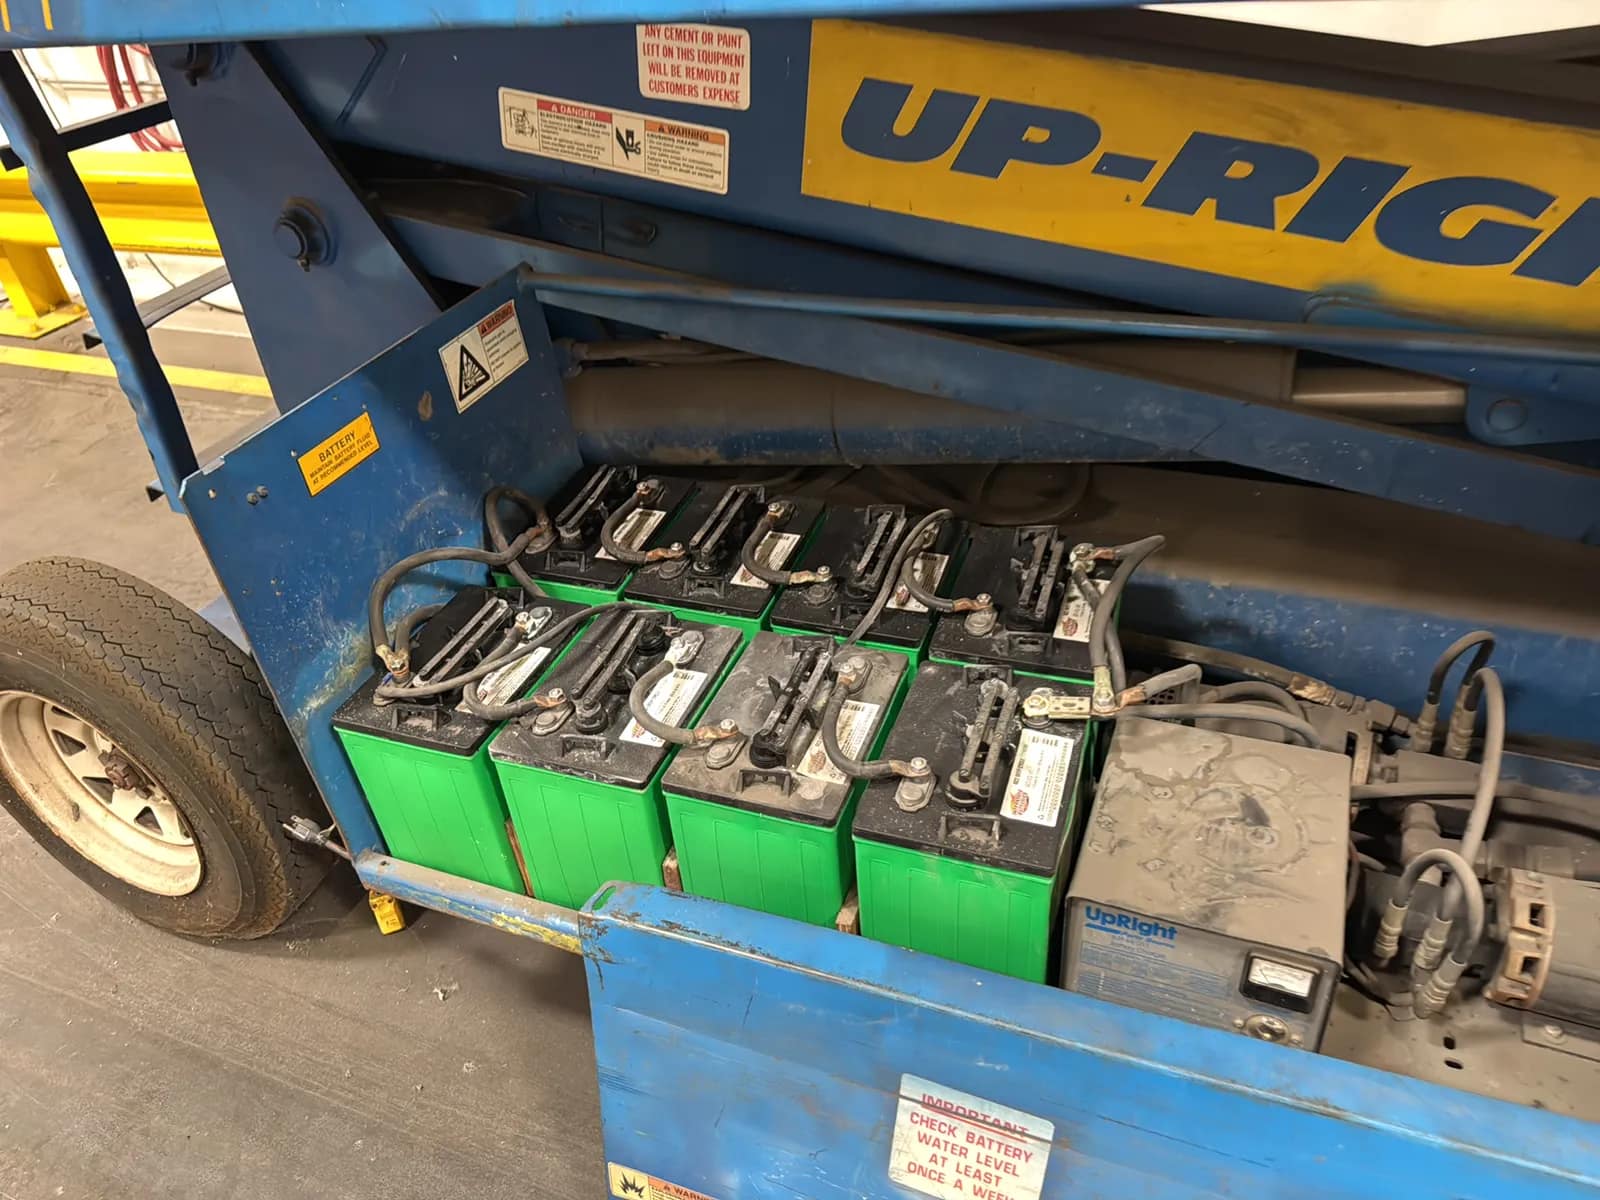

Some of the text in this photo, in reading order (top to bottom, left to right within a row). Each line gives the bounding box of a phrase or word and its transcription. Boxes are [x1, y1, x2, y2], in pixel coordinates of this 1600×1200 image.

[644, 24, 743, 49] ANY CEMENT OR PAINT
[643, 42, 745, 68] LEFT ON THIS EQUIPMENT
[648, 61, 740, 86] WILL BE REMOVED AT
[648, 80, 740, 103] CUSTOMERS EXPENSE
[560, 104, 596, 119] DANGER
[667, 124, 710, 141] WARNING
[318, 430, 356, 462] BATTERY
[334, 443, 356, 461] BATTERY
[357, 440, 373, 453] LEVEL
[1085, 905, 1178, 940] UpRight
[921, 1093, 1030, 1137] IMPORTANT
[910, 1111, 1033, 1164] CHECK BATTERY
[917, 1130, 1020, 1178] WATER LEVEL
[907, 1161, 946, 1184] ONCE
[953, 1179, 963, 1191] A
[928, 1153, 1004, 1188] AT LEAST
